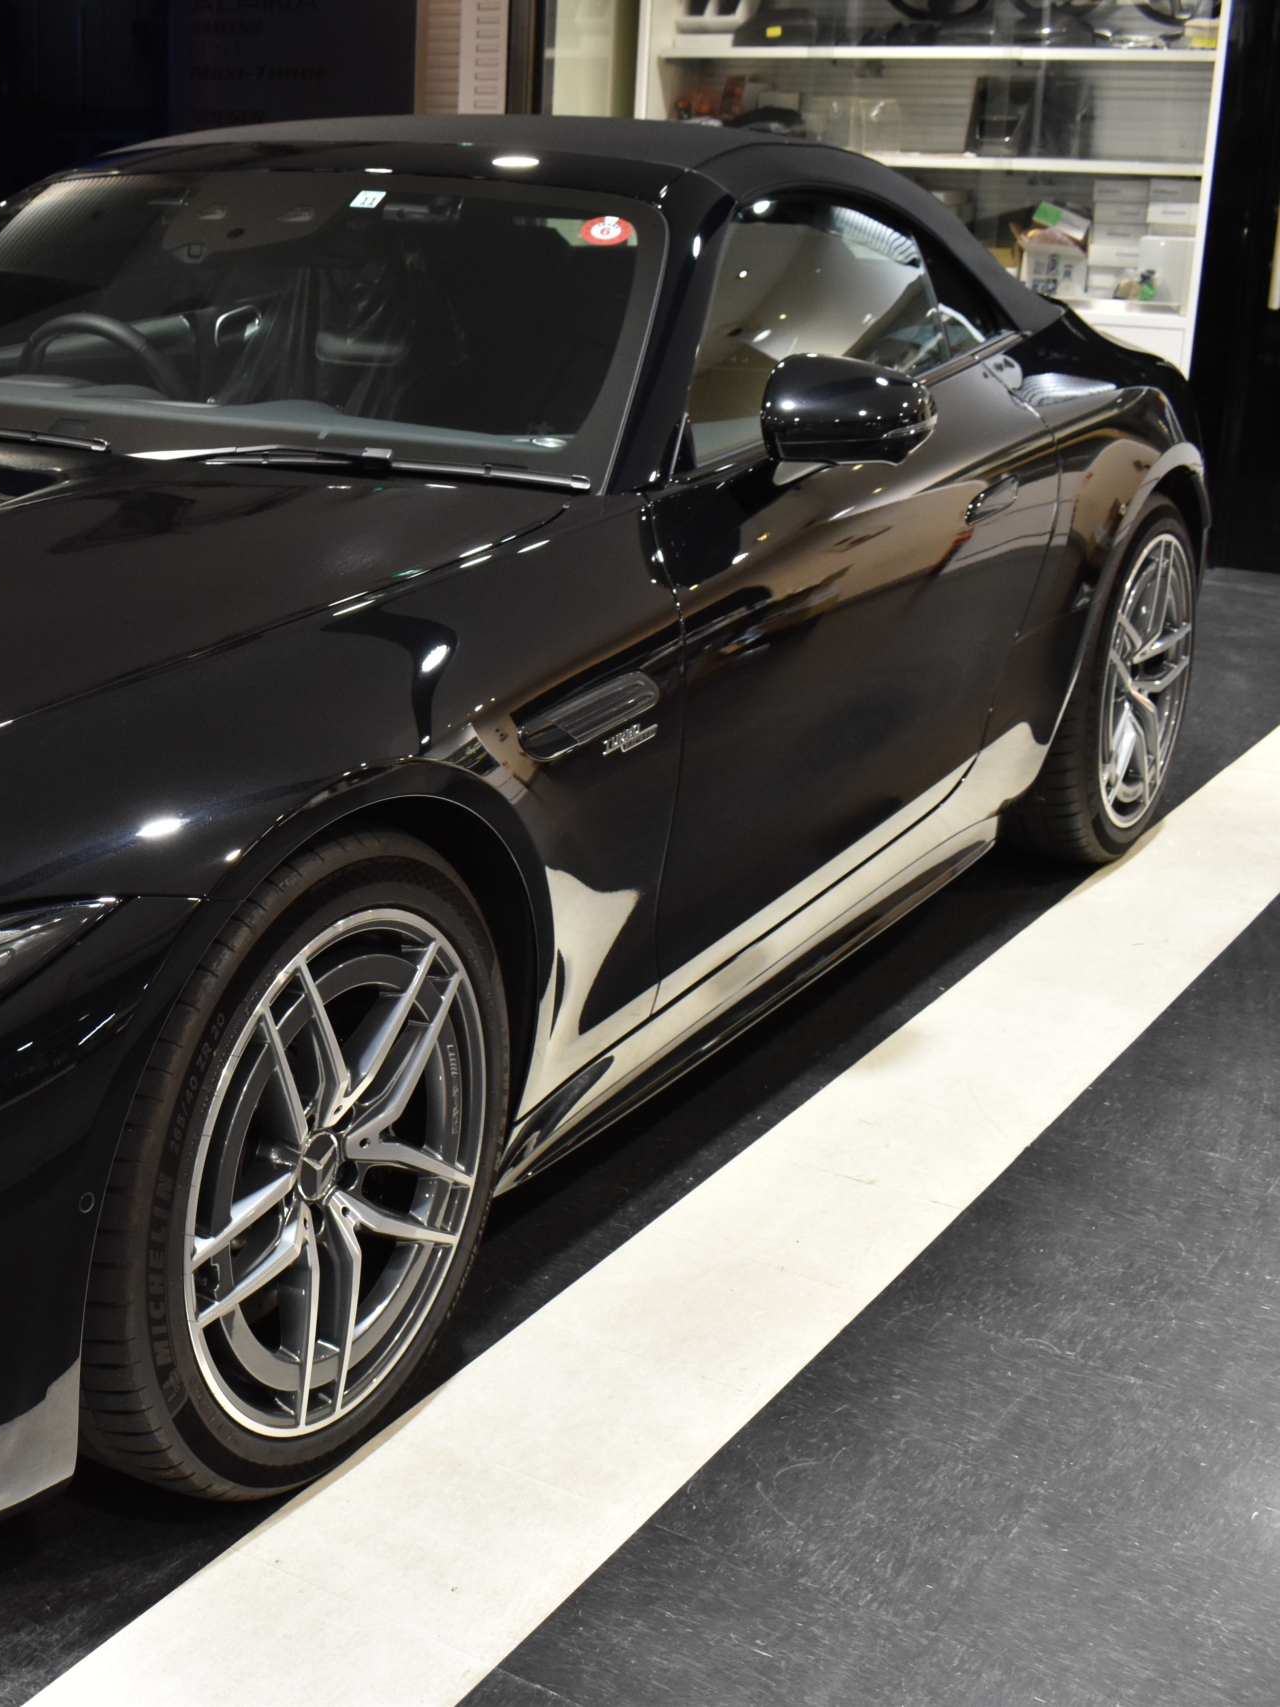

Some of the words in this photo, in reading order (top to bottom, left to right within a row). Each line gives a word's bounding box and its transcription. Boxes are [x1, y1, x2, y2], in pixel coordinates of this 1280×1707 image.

[360, 196, 377, 206] 11
[171, 1076, 198, 1154] 265/40
[196, 1043, 212, 1072] ZR
[211, 1012, 225, 1040] 20
[148, 1172, 176, 1366] MICHELIN
